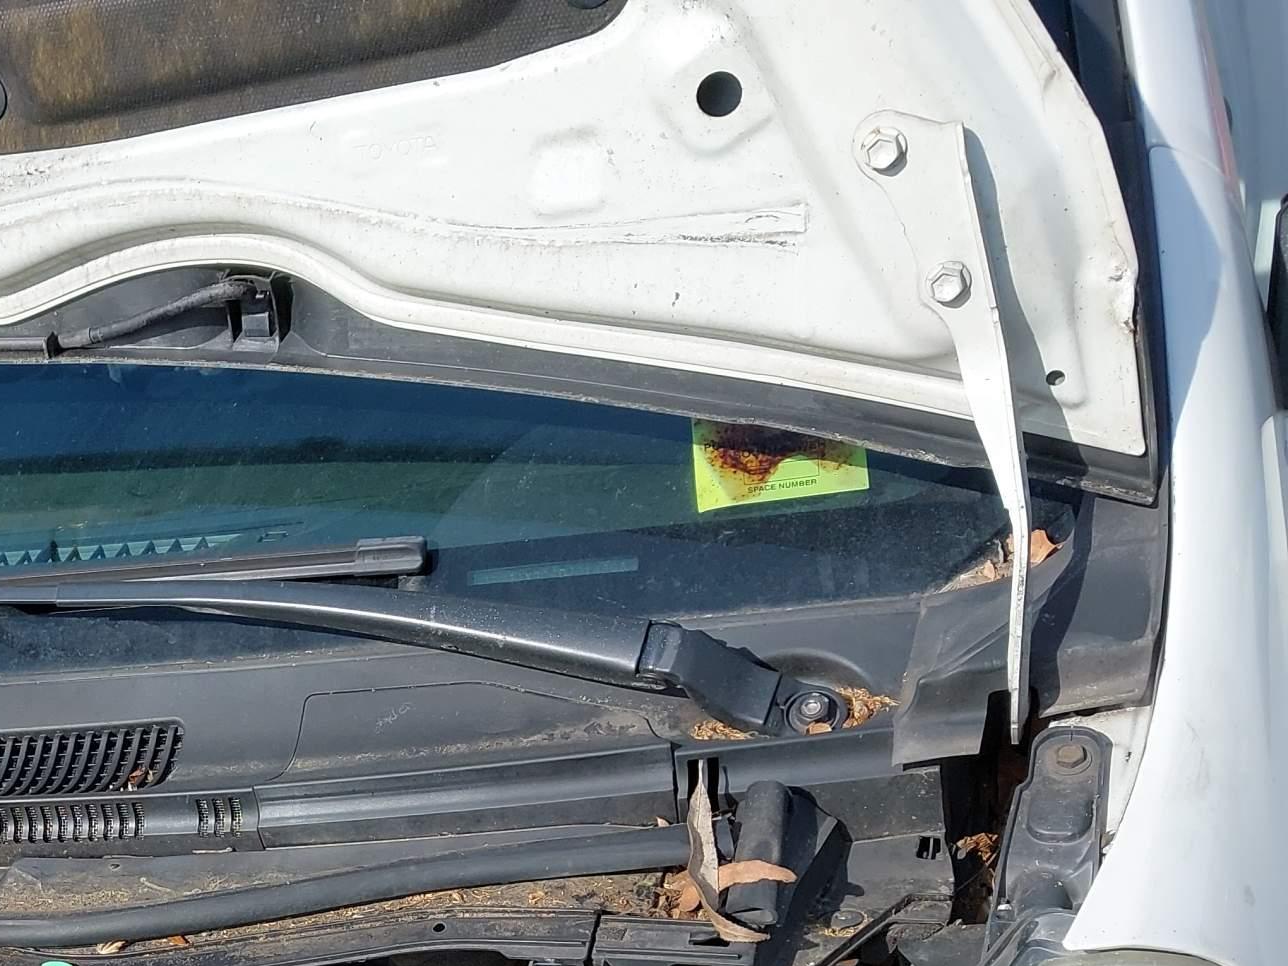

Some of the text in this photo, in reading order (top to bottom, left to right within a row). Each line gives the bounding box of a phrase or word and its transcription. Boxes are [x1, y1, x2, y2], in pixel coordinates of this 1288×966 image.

[351, 135, 438, 161] TOYOTA
[747, 479, 817, 494] SPACE NUMBER
